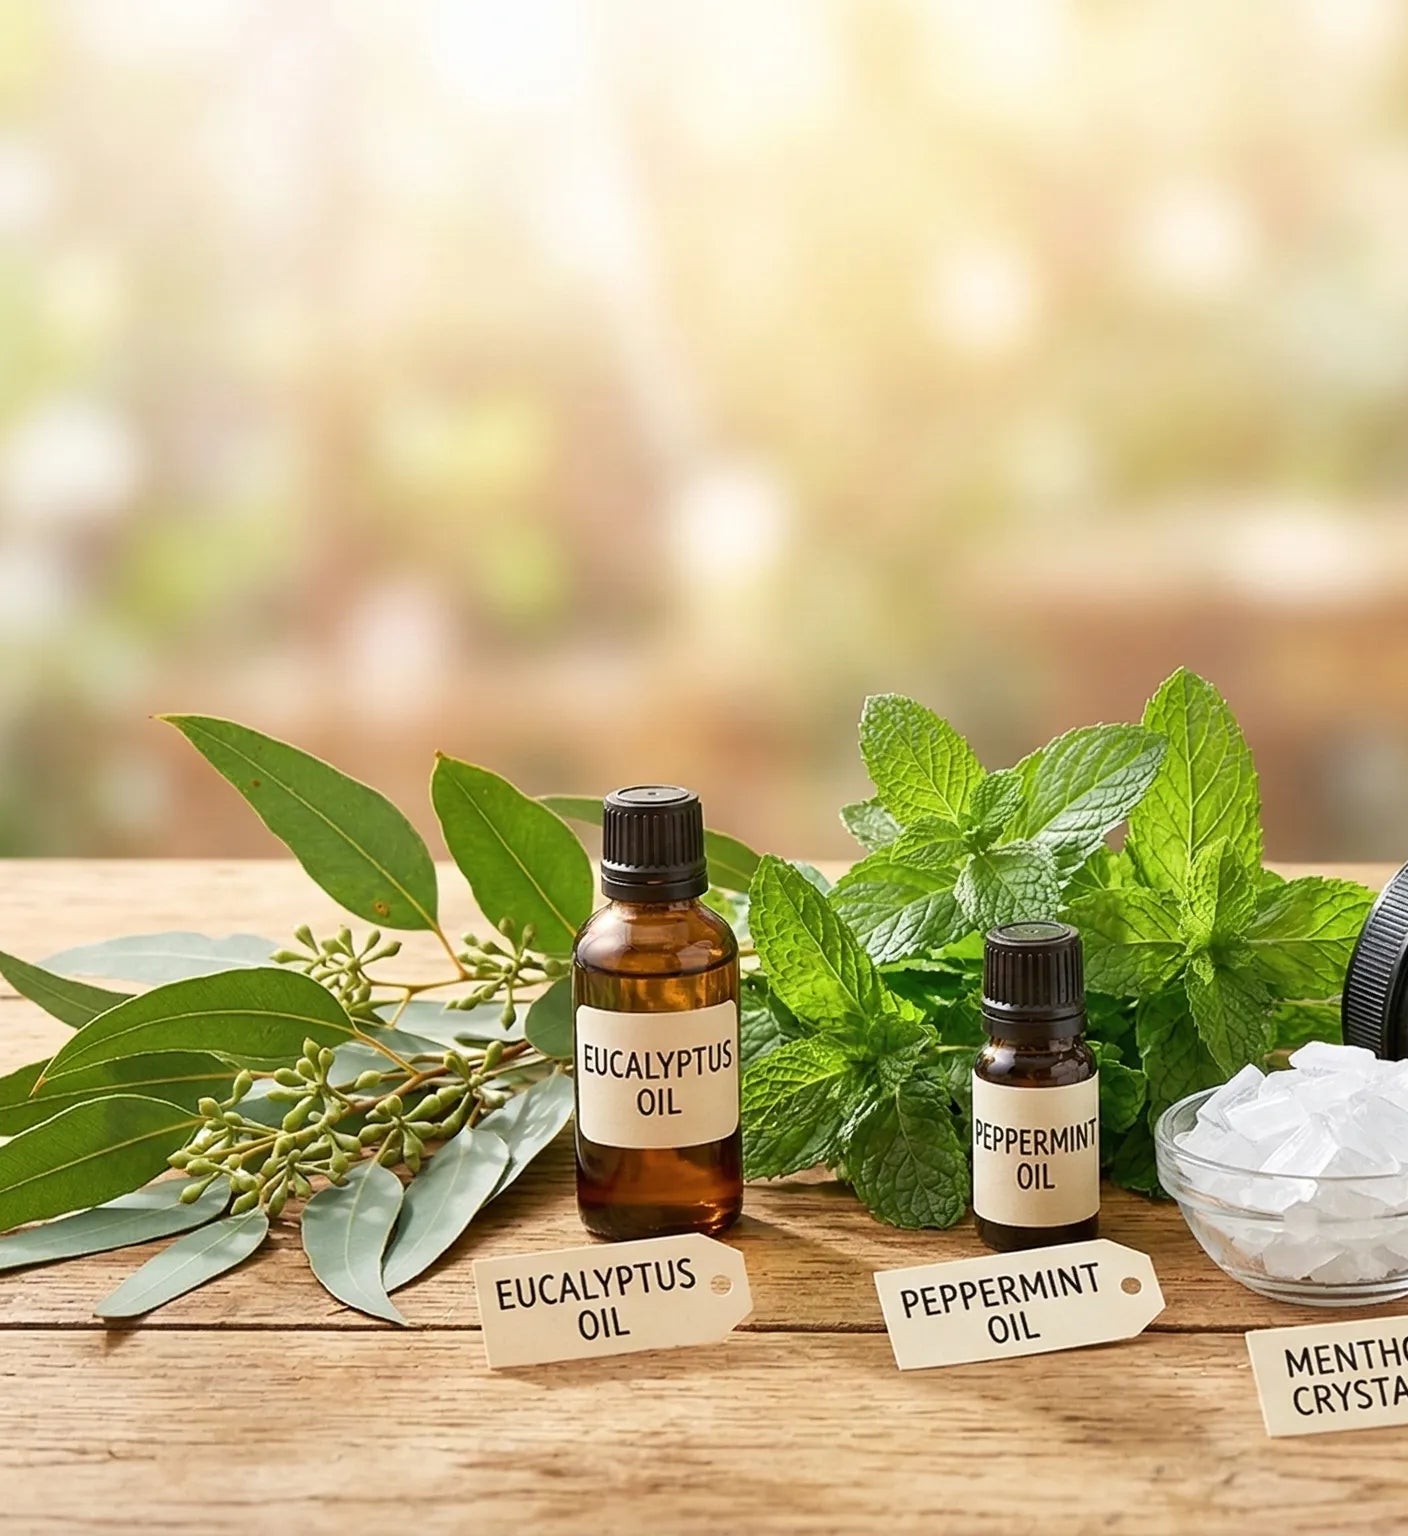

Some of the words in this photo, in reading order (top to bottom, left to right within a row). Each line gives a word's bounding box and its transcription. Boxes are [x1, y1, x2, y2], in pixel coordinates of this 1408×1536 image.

[584, 1039, 732, 1080] EUCALYPTUS
[636, 1087, 683, 1117] OIL
[975, 1117, 1097, 1157] PEPPERMINT
[1016, 1162, 1056, 1190] OIL
[495, 1257, 696, 1311] EUCALYPTUS
[900, 1262, 1099, 1319] PEPPERMINT
[578, 1306, 631, 1341] OIL
[987, 1311, 1041, 1344] OIL
